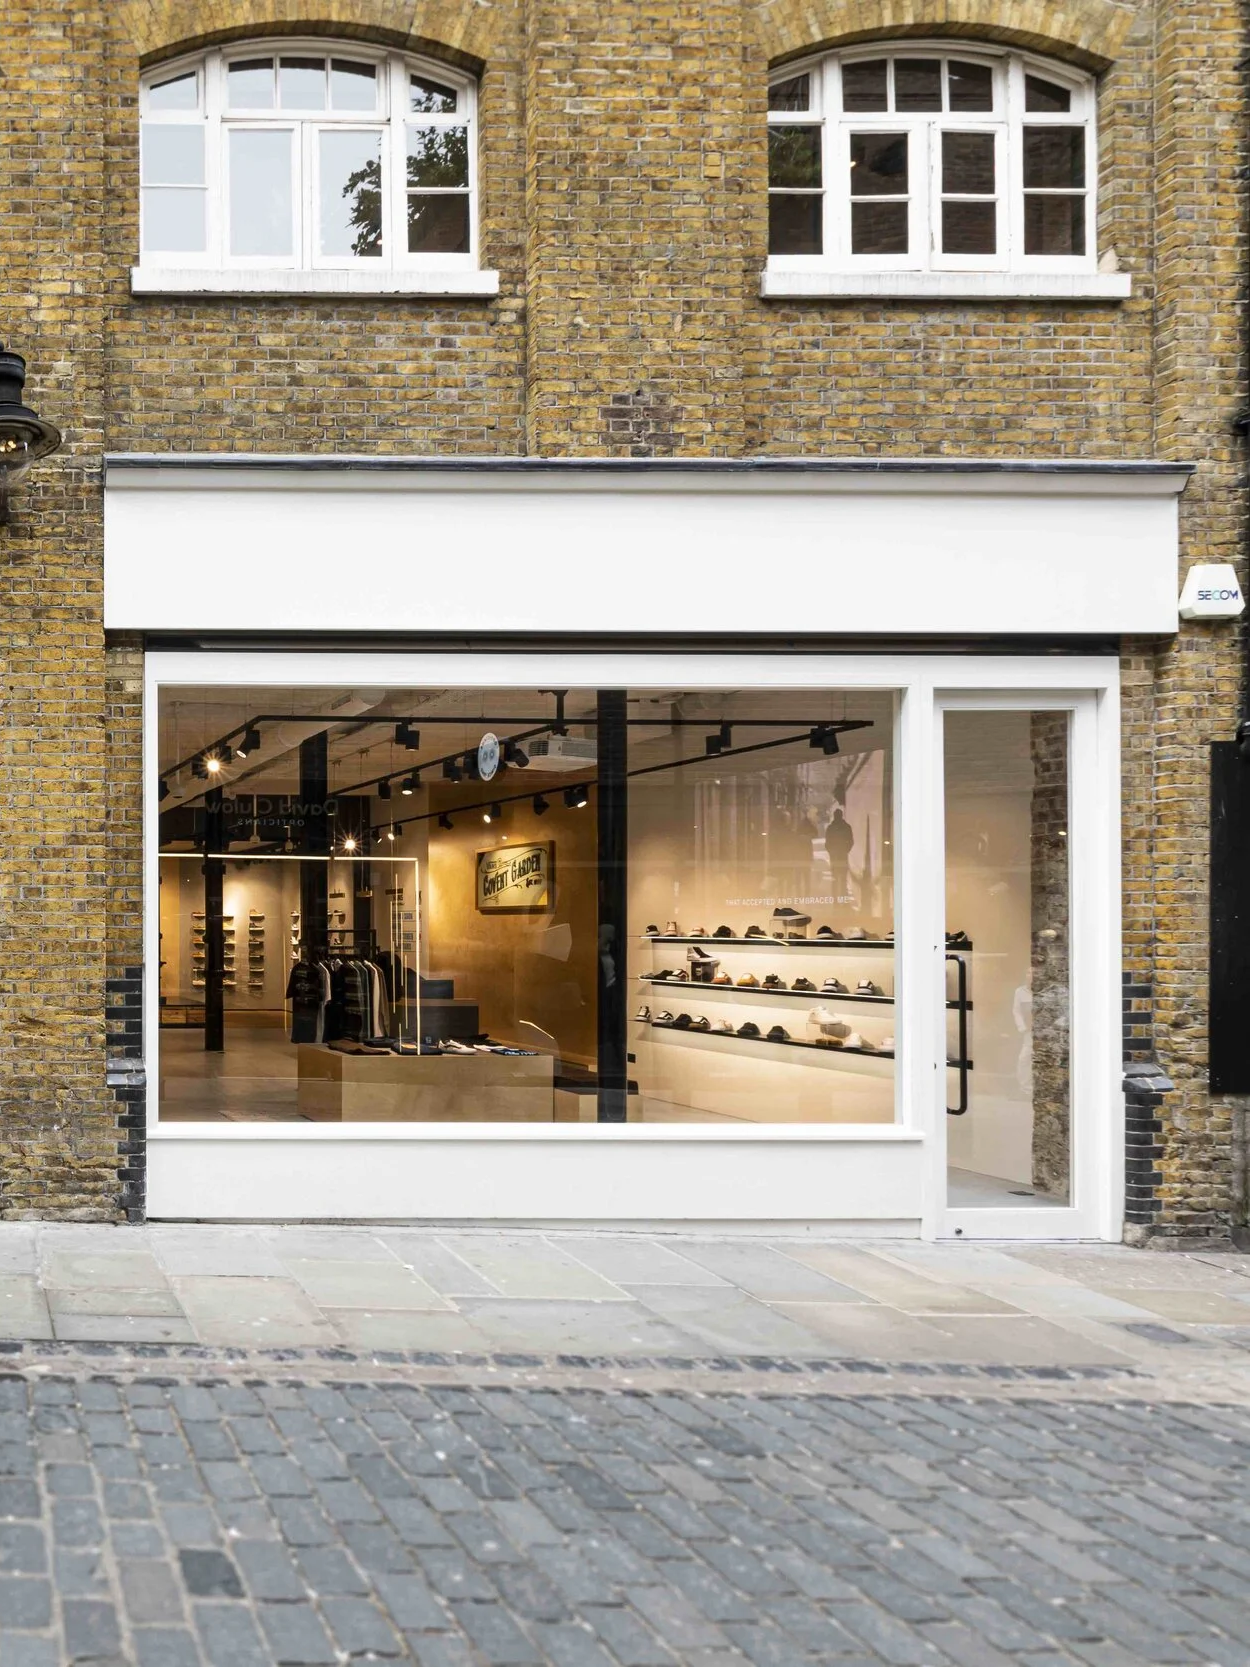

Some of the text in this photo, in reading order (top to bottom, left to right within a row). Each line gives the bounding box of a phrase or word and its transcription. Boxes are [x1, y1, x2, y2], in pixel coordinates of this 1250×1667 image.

[1197, 590, 1239, 600] SECOM
[483, 853, 541, 896] COVENT GARDEN
[742, 898, 776, 906] ACCEPTED
[794, 897, 834, 905] EMBRACED
